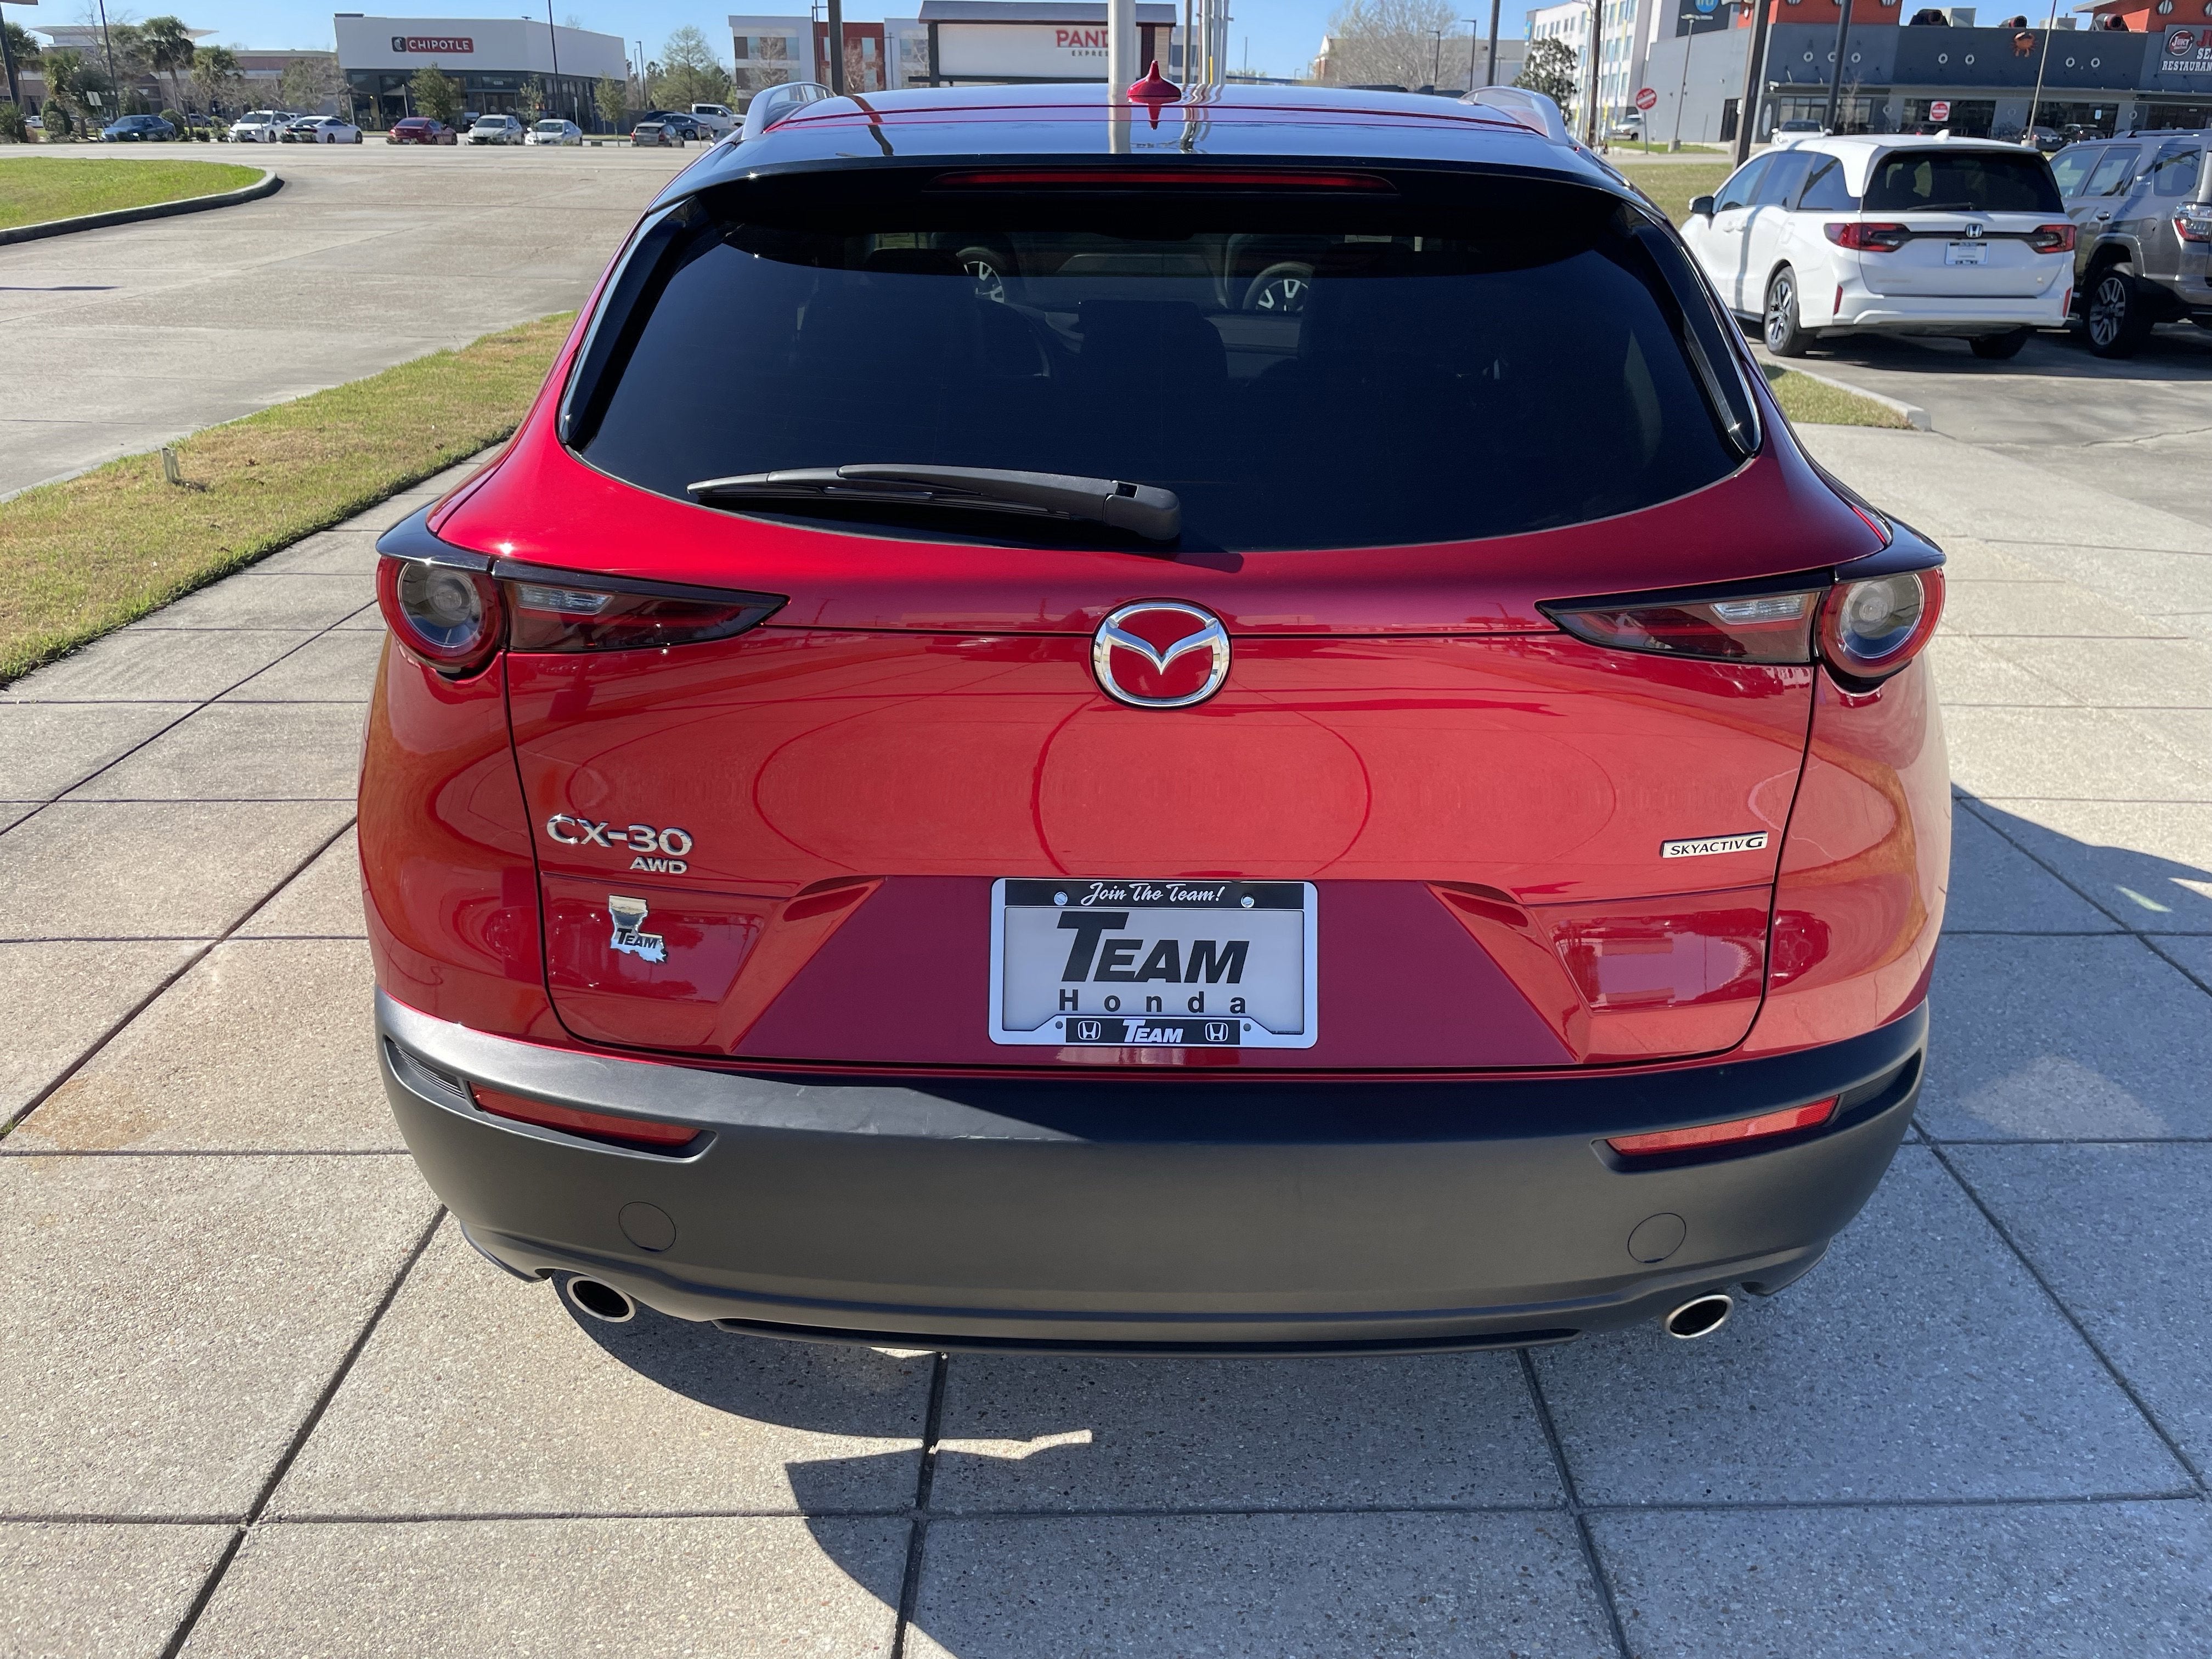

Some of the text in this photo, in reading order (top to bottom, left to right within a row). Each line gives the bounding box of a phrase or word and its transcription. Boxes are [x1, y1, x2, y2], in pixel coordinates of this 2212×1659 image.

[409, 40, 470, 50] CHIPOTLE
[1056, 30, 1108, 48] PAN
[2162, 60, 2212, 71] RESTAURAN
[546, 814, 693, 856] CX-30
[629, 856, 687, 874] AWD
[1080, 882, 1226, 906] Join The Team!
[617, 928, 658, 949] TEAM
[1057, 911, 1250, 984] TEAM
[1059, 989, 1246, 1014] Honda
[1122, 1019, 1184, 1042] TEAM
